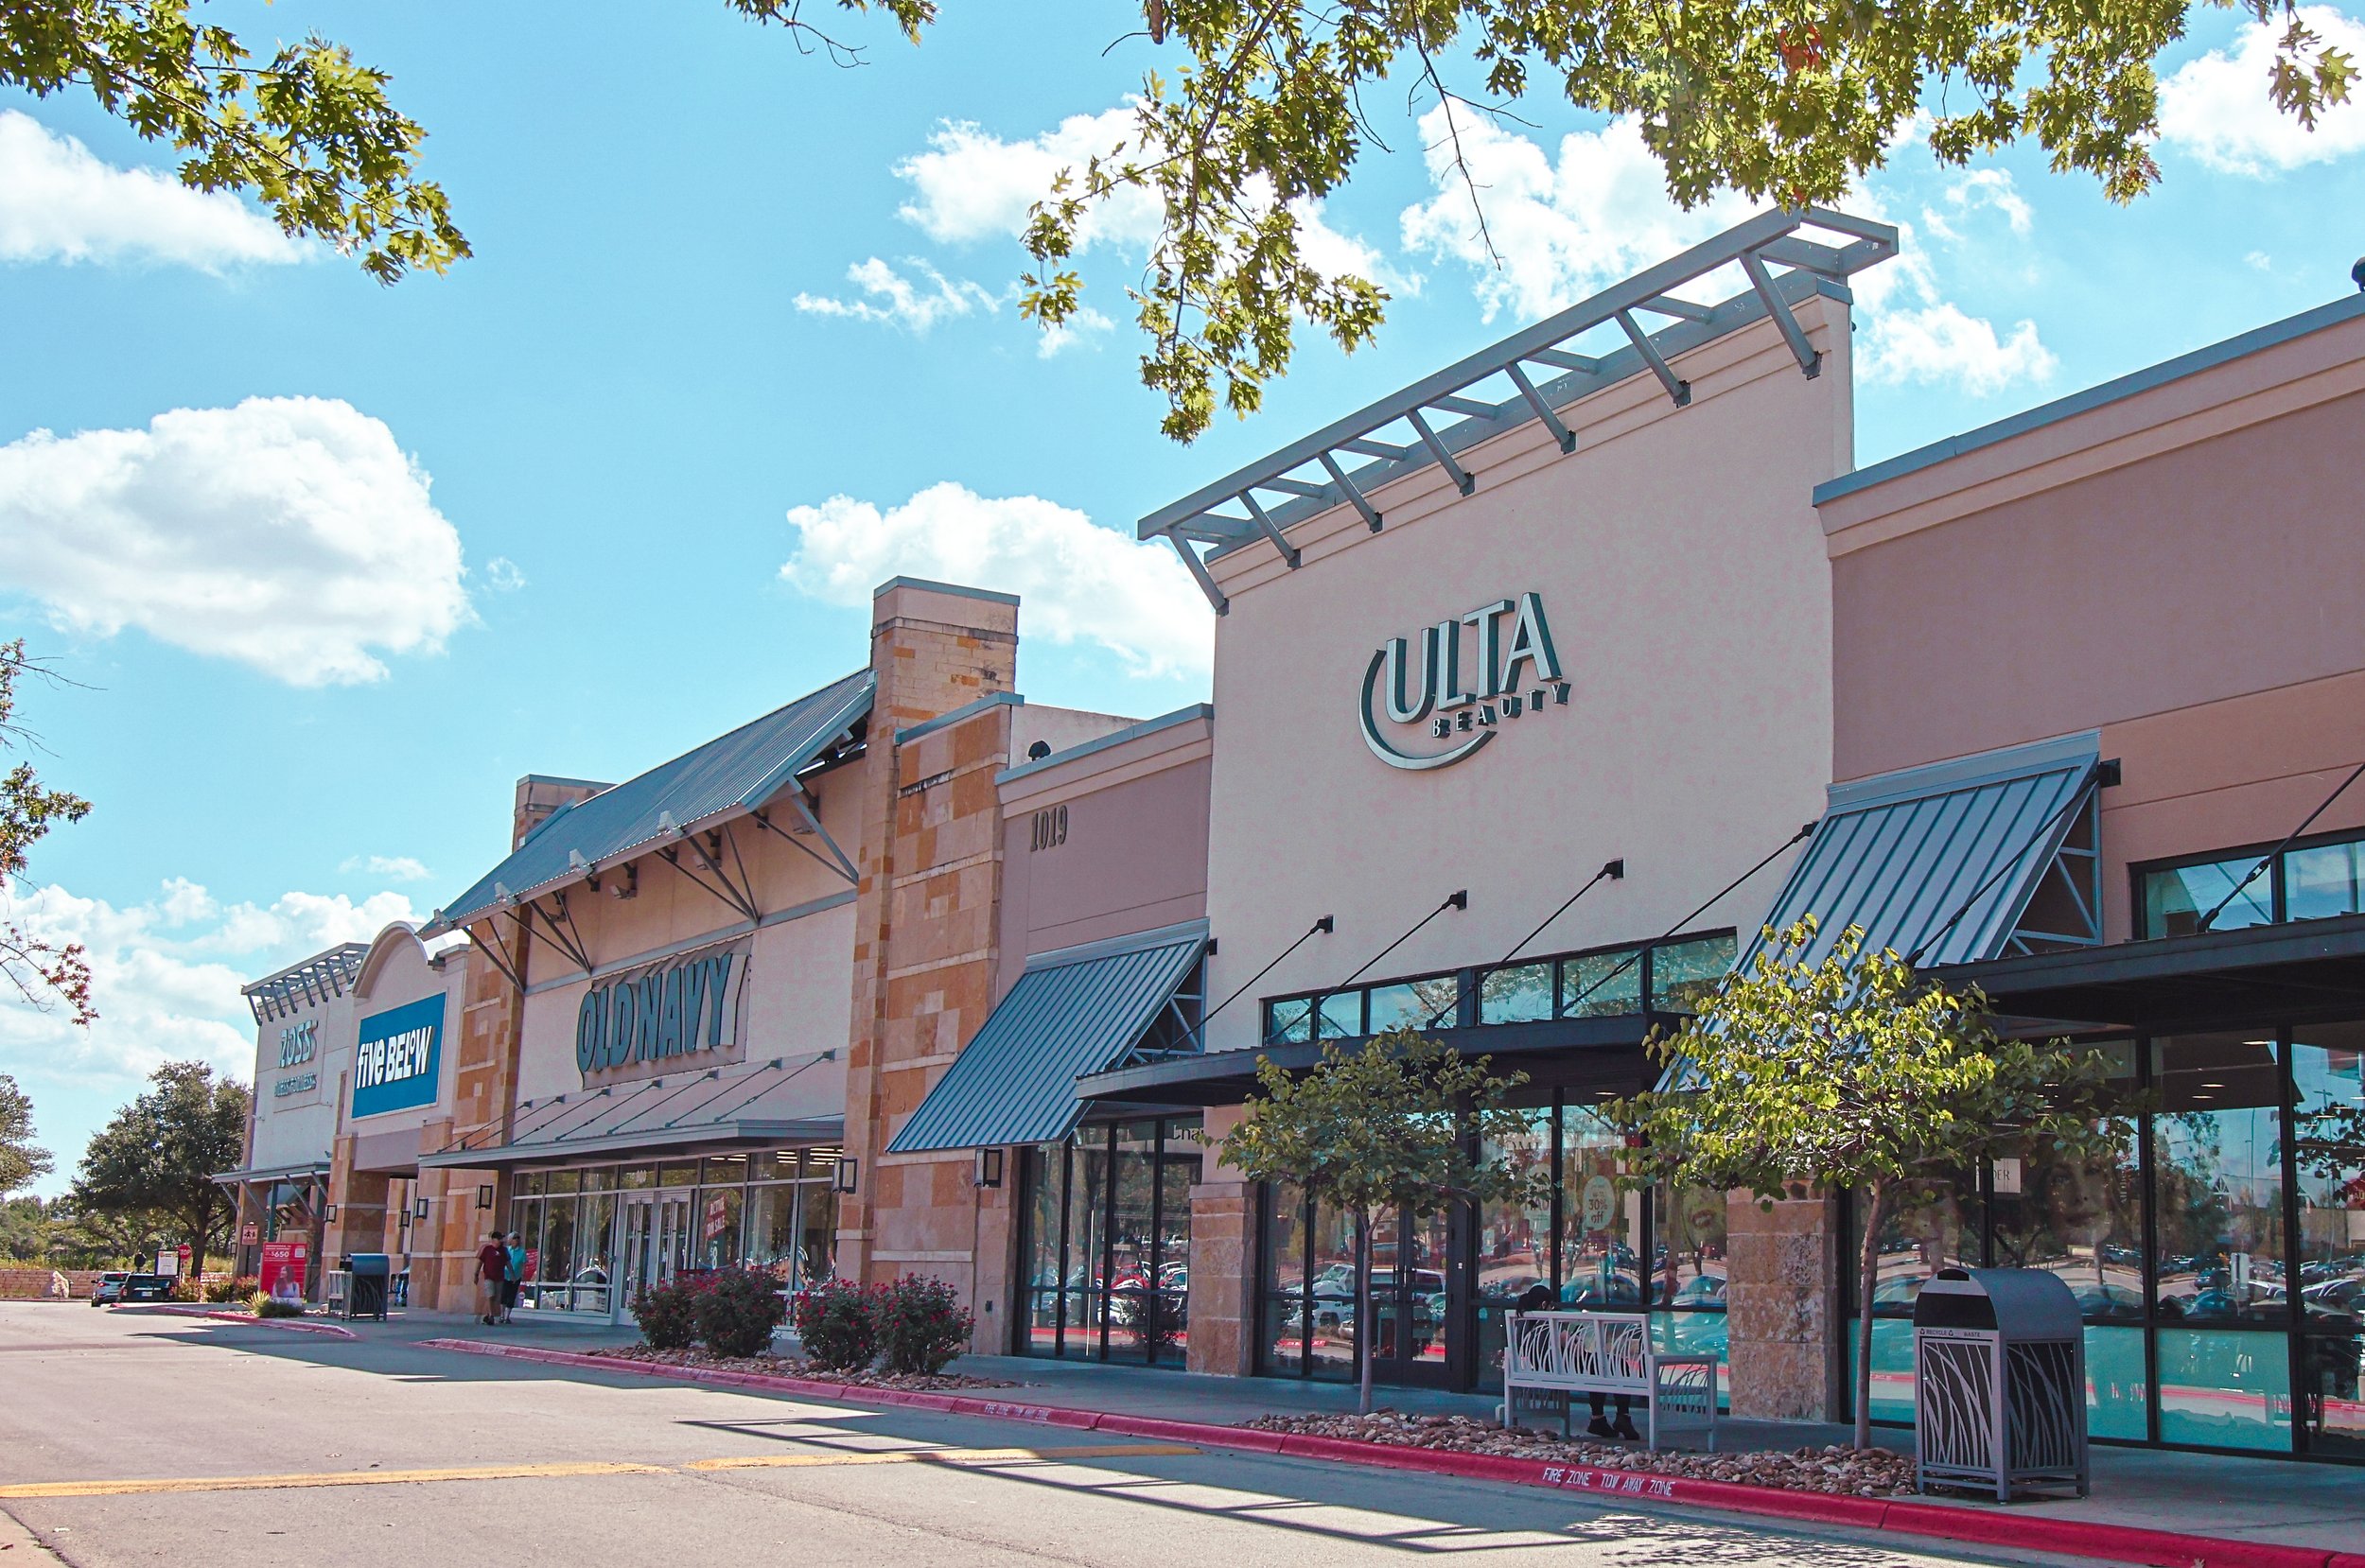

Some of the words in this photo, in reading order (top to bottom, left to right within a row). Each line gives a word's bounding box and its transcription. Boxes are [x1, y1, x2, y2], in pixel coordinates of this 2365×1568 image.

[1386, 592, 1563, 723] ULTA
[1431, 682, 1571, 739] BEAUTY
[1030, 805, 1068, 852] 1019
[576, 983, 635, 1072] OLD
[635, 952, 735, 1063] NAVY
[1588, 1198, 1608, 1211] 30%
[1590, 1211, 1604, 1224] off
[1542, 1467, 1566, 1483] FIRE
[1567, 1470, 1593, 1486] ZONE
[1601, 1473, 1620, 1489] TOW
[1622, 1477, 1645, 1492] AWAY
[1648, 1479, 1676, 1496] ZONE
